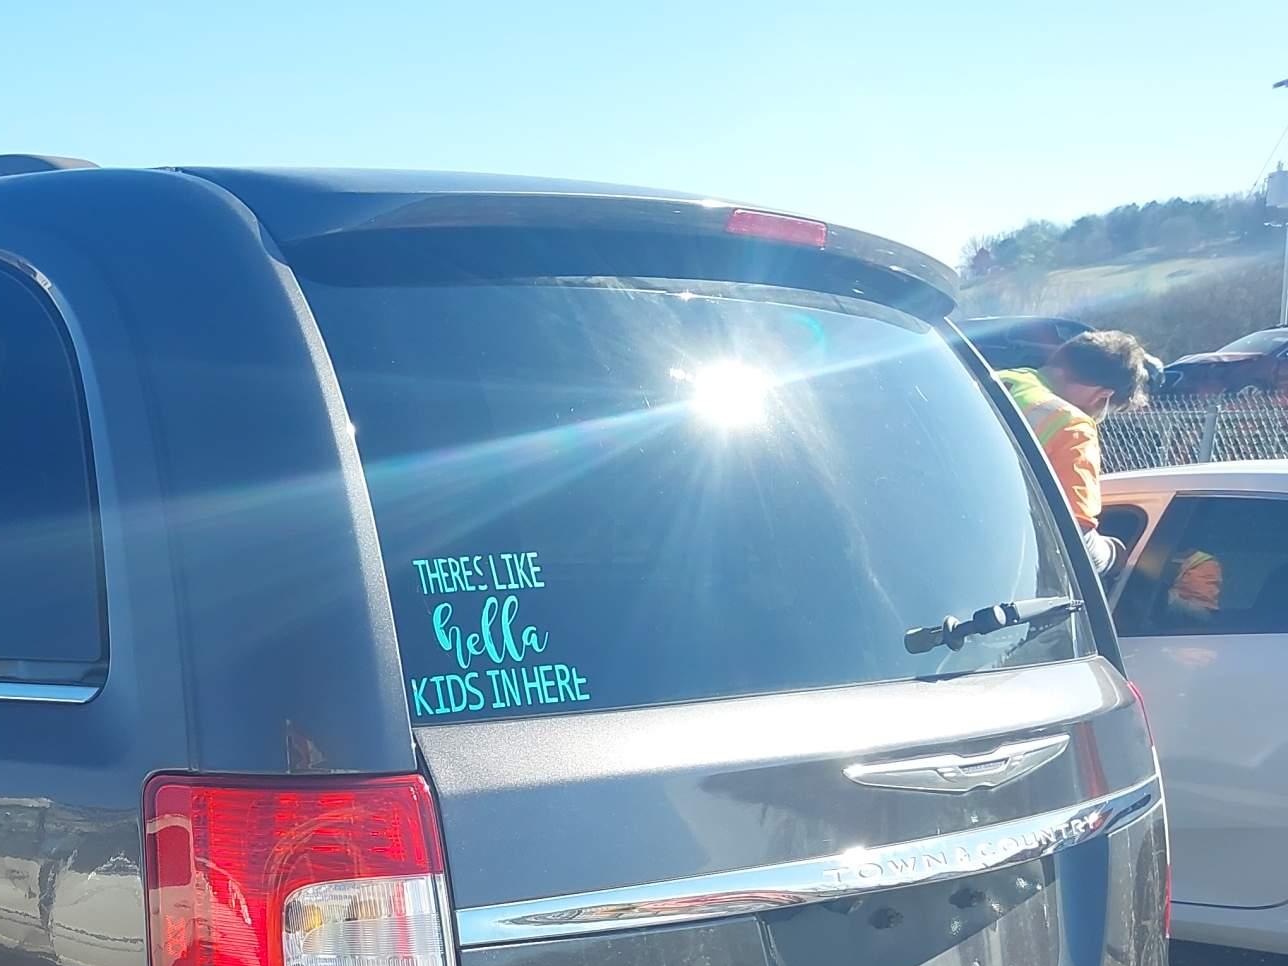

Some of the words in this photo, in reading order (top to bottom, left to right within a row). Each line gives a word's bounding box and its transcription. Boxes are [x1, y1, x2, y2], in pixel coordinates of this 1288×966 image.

[412, 556, 489, 595] THERES
[488, 552, 545, 590] LIKE
[432, 595, 549, 669] hella
[411, 671, 485, 717] KIDS
[485, 667, 522, 709] IN
[520, 663, 591, 706] HERE
